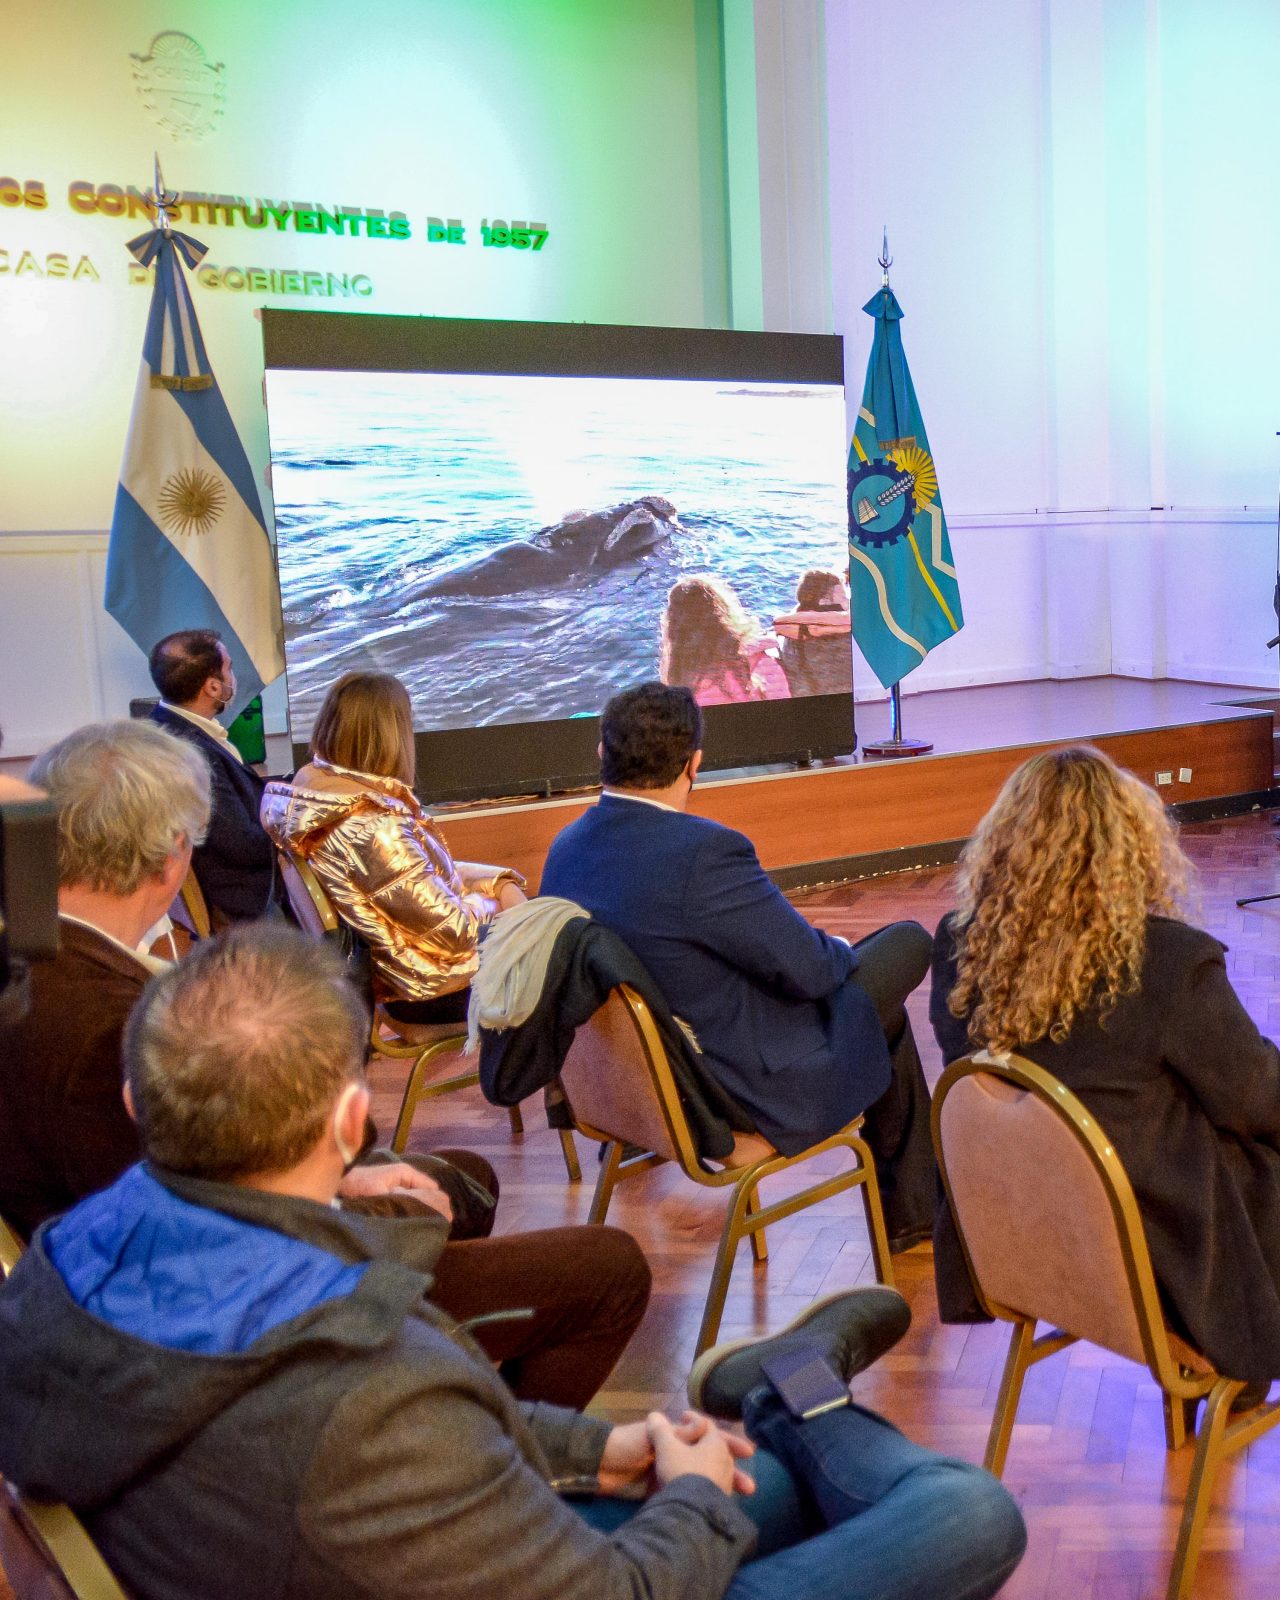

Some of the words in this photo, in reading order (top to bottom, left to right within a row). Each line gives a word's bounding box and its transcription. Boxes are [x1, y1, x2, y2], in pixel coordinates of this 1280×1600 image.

[427, 217, 466, 245] DE
[480, 219, 549, 250] 1957
[197, 262, 374, 298] GOBIERNO
